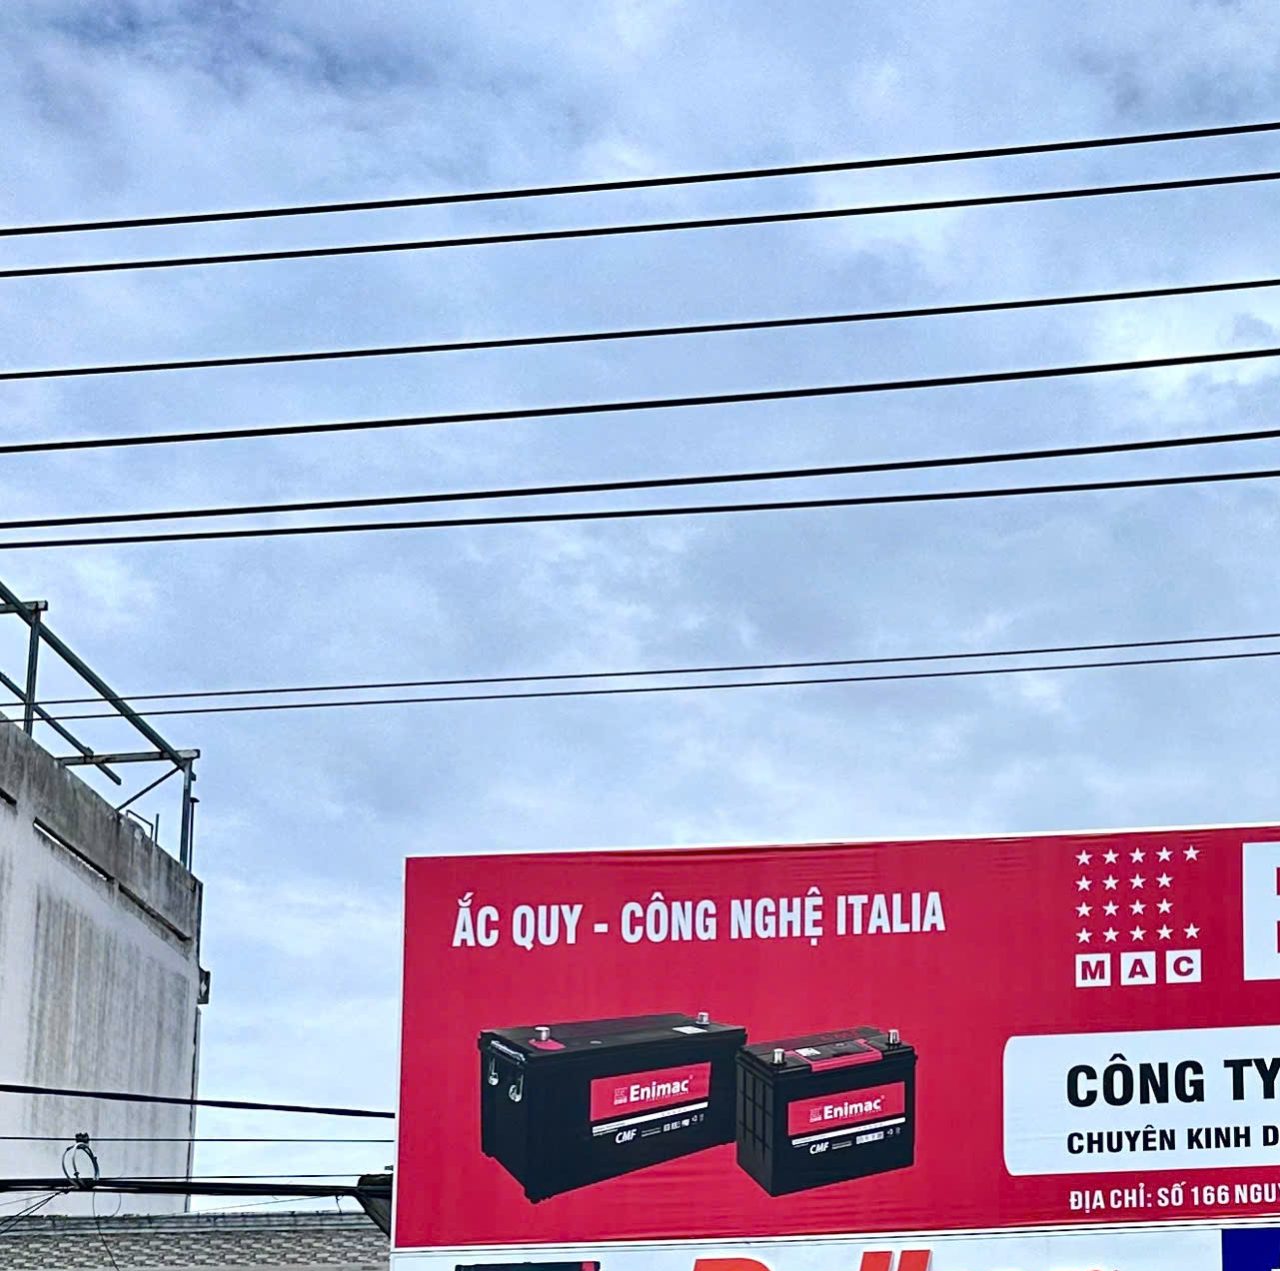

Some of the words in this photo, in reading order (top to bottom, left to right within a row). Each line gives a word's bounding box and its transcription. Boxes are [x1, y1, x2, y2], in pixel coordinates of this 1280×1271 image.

[452, 892, 499, 947] ẮC
[512, 904, 582, 951] QUY
[621, 892, 717, 943] CÔNG
[730, 887, 824, 946] NGHỆ
[836, 892, 947, 935] ITALIA
[629, 1078, 690, 1102] Enimac
[1066, 1053, 1205, 1108] CÔNG
[823, 1097, 881, 1120] Enimac
[1067, 1124, 1176, 1155] CHUYÊN
[1186, 1125, 1251, 1150] KINH
[1069, 1189, 1105, 1213] ĐỊA
[1111, 1182, 1153, 1209] CHỈ:
[1156, 1180, 1187, 1207] SỐ
[1191, 1184, 1229, 1206] 166
